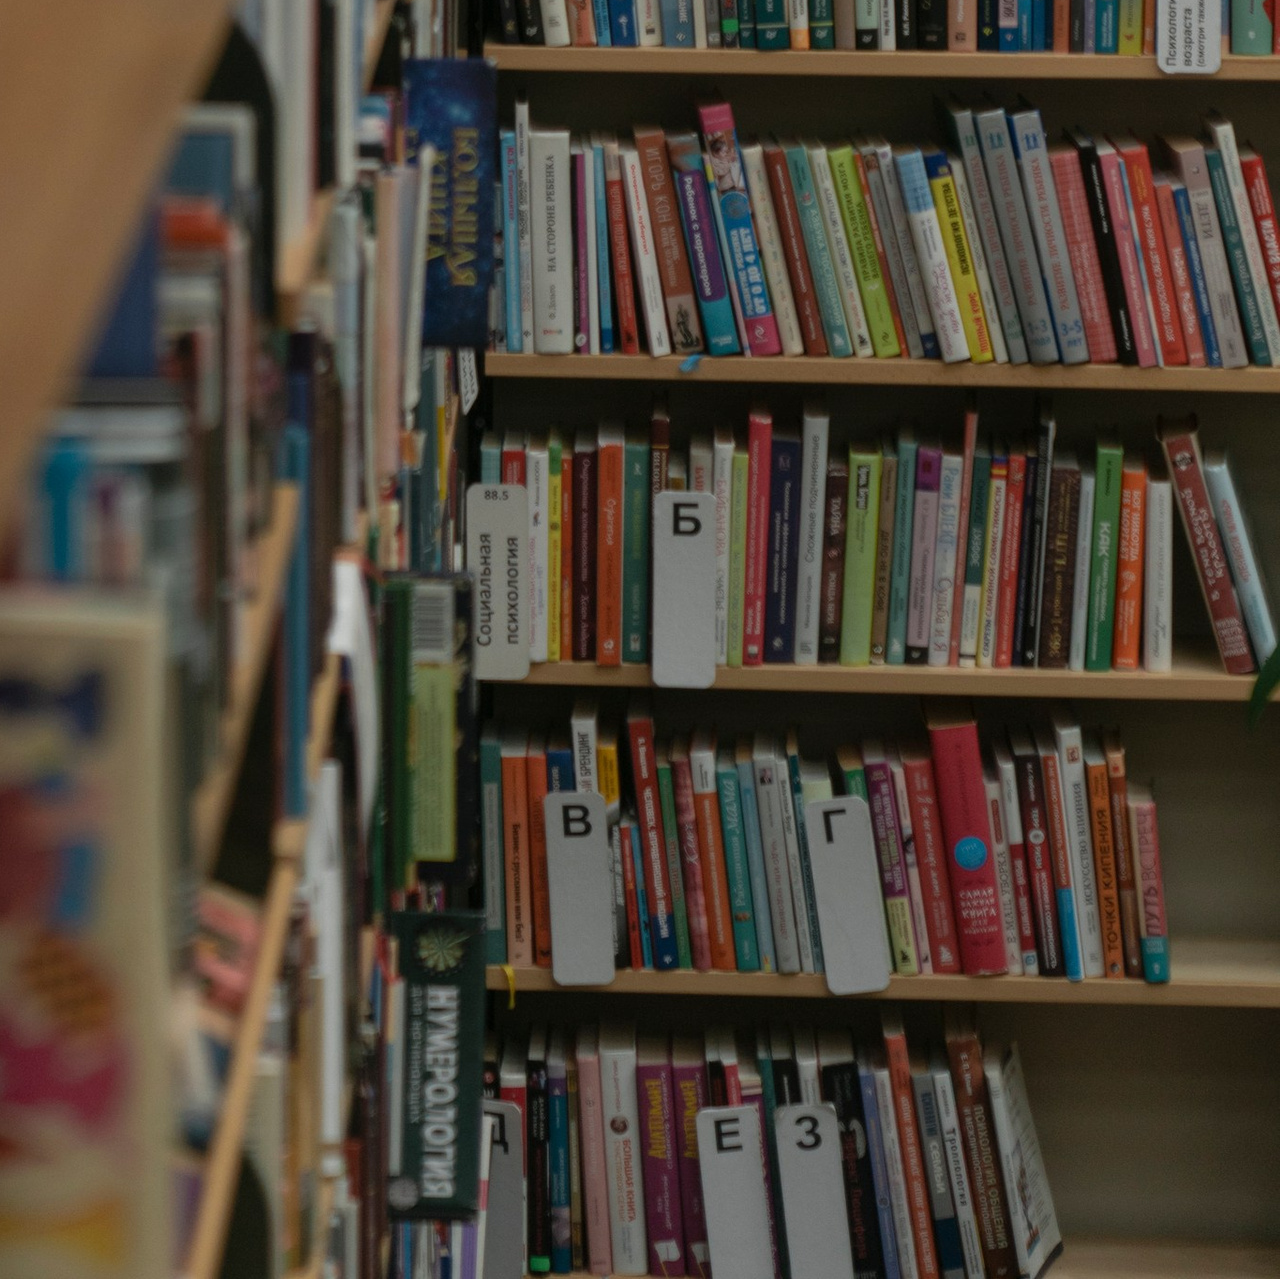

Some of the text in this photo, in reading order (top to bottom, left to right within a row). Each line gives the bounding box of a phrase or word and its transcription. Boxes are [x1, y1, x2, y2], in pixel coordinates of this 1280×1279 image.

[1181, 9, 1193, 67] возраста
[1195, 27, 1207, 68] (смотри
[545, 155, 557, 272] НА СТОРОНЕ РЕБЕНКА
[683, 176, 700, 213] Ребенок
[692, 231, 712, 296] характером
[483, 492, 510, 501] 88.5
[672, 504, 702, 538] Б
[804, 436, 820, 564] Сложные подчиненные
[1097, 522, 1111, 558] КАК
[477, 534, 494, 648] Социальная
[504, 537, 520, 647] психология
[561, 804, 592, 838] В
[821, 809, 847, 845] Г
[1072, 782, 1094, 908] ИСКУССТВО ВЛИЯНИЯ
[1095, 808, 1119, 954] ТОЧКИ КИПЕНИЯ
[421, 985, 460, 1198] НУМЕРОЛОГИЯ
[714, 1117, 743, 1154] Е
[795, 1116, 822, 1151] З
[947, 1128, 968, 1207] Троллология
